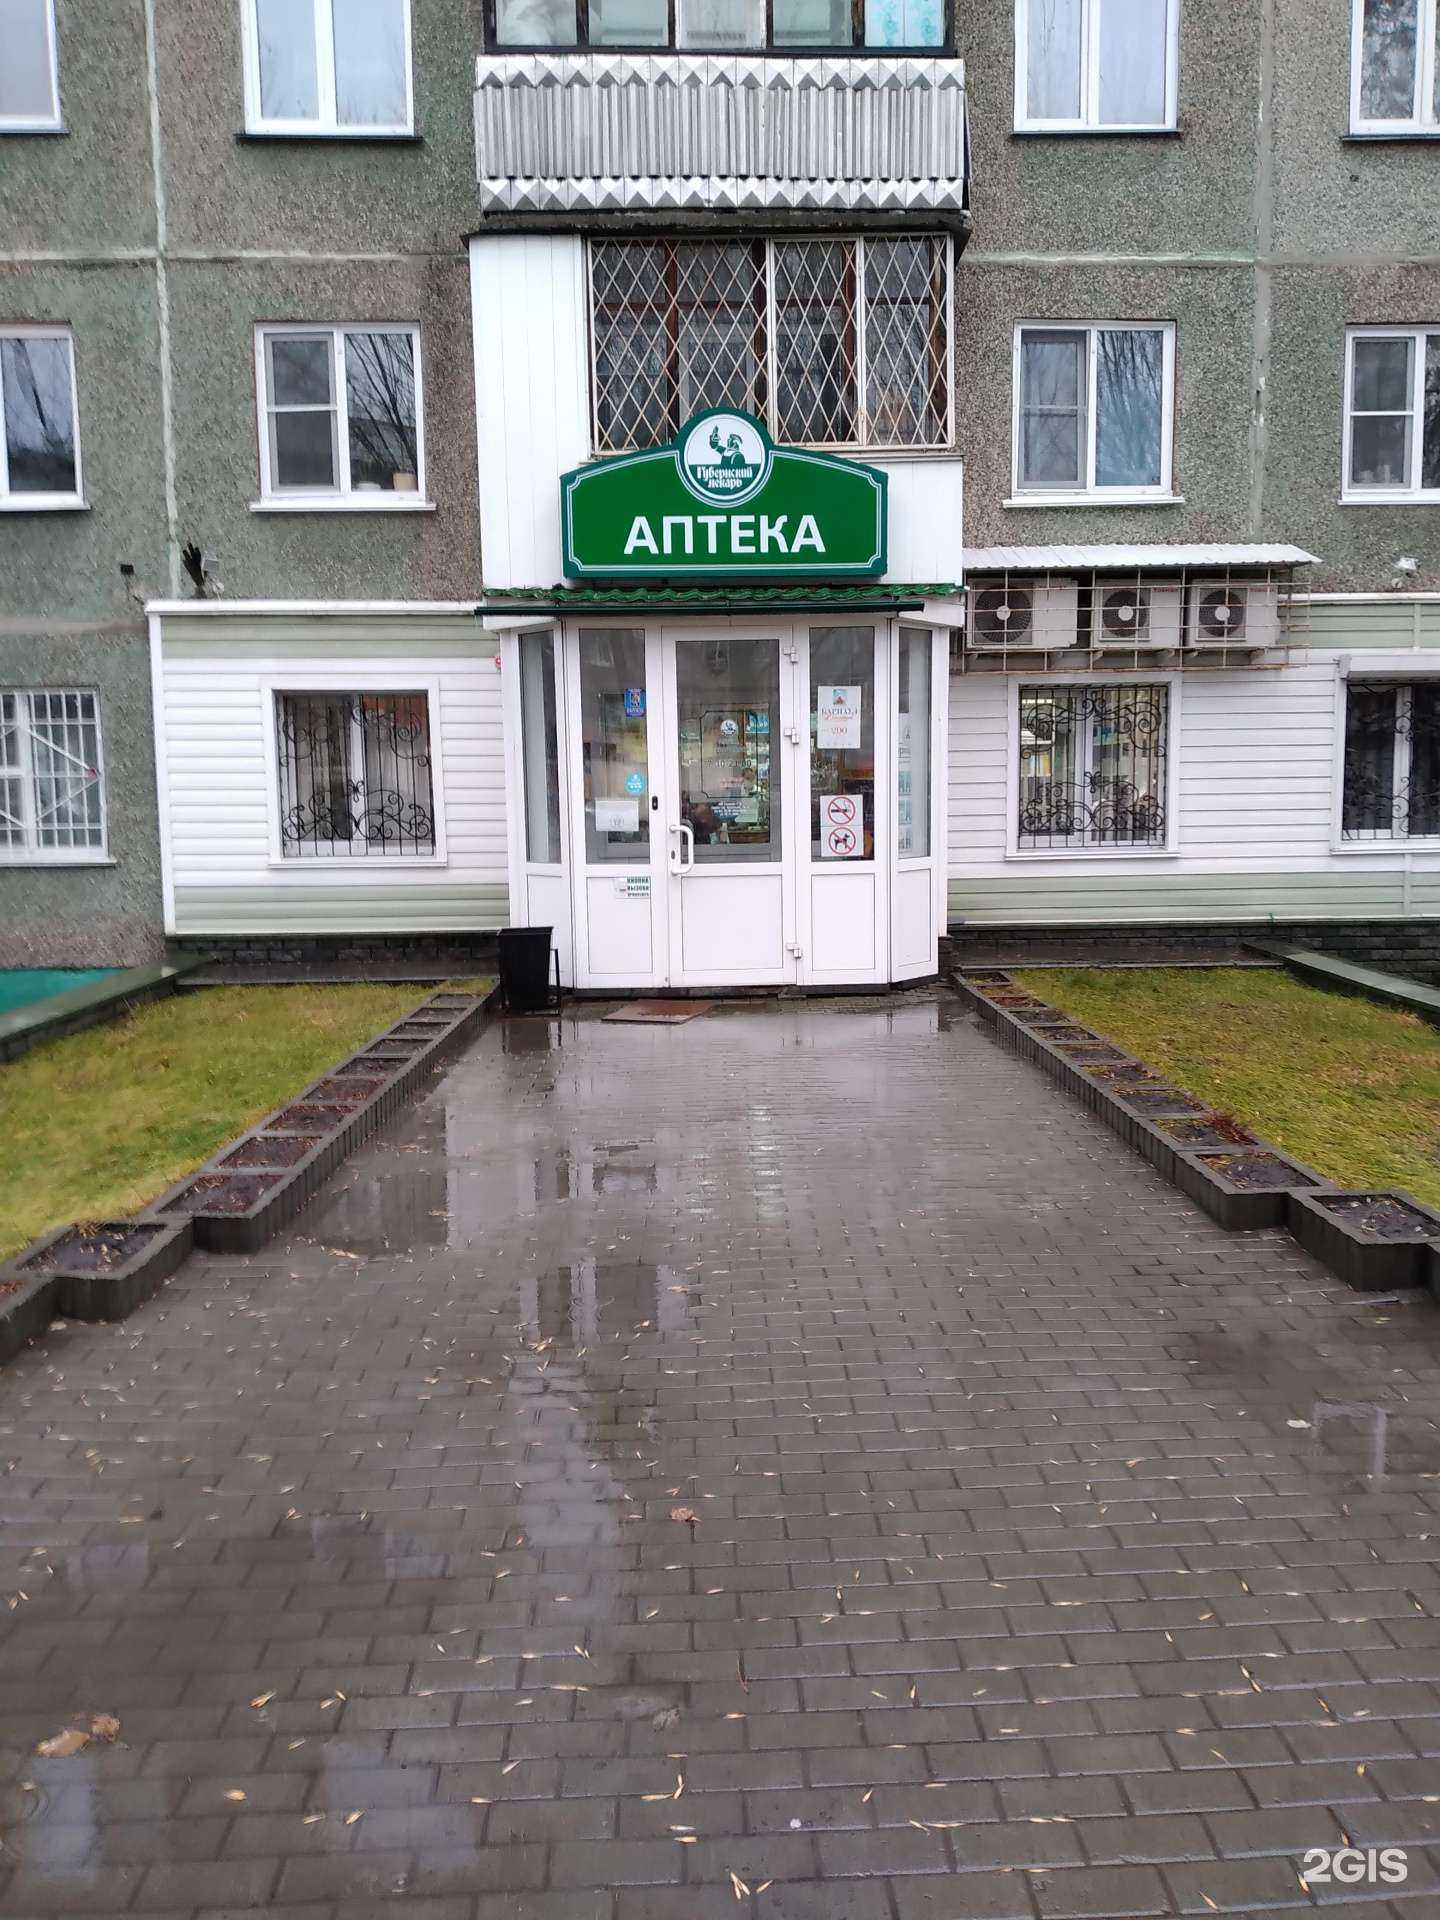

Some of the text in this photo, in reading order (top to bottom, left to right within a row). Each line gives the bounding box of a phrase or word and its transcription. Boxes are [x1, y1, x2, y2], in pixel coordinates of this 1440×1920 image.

[697, 466, 753, 481] Губернский
[708, 478, 742, 490] лекарь
[623, 515, 826, 555] АПТЕКА
